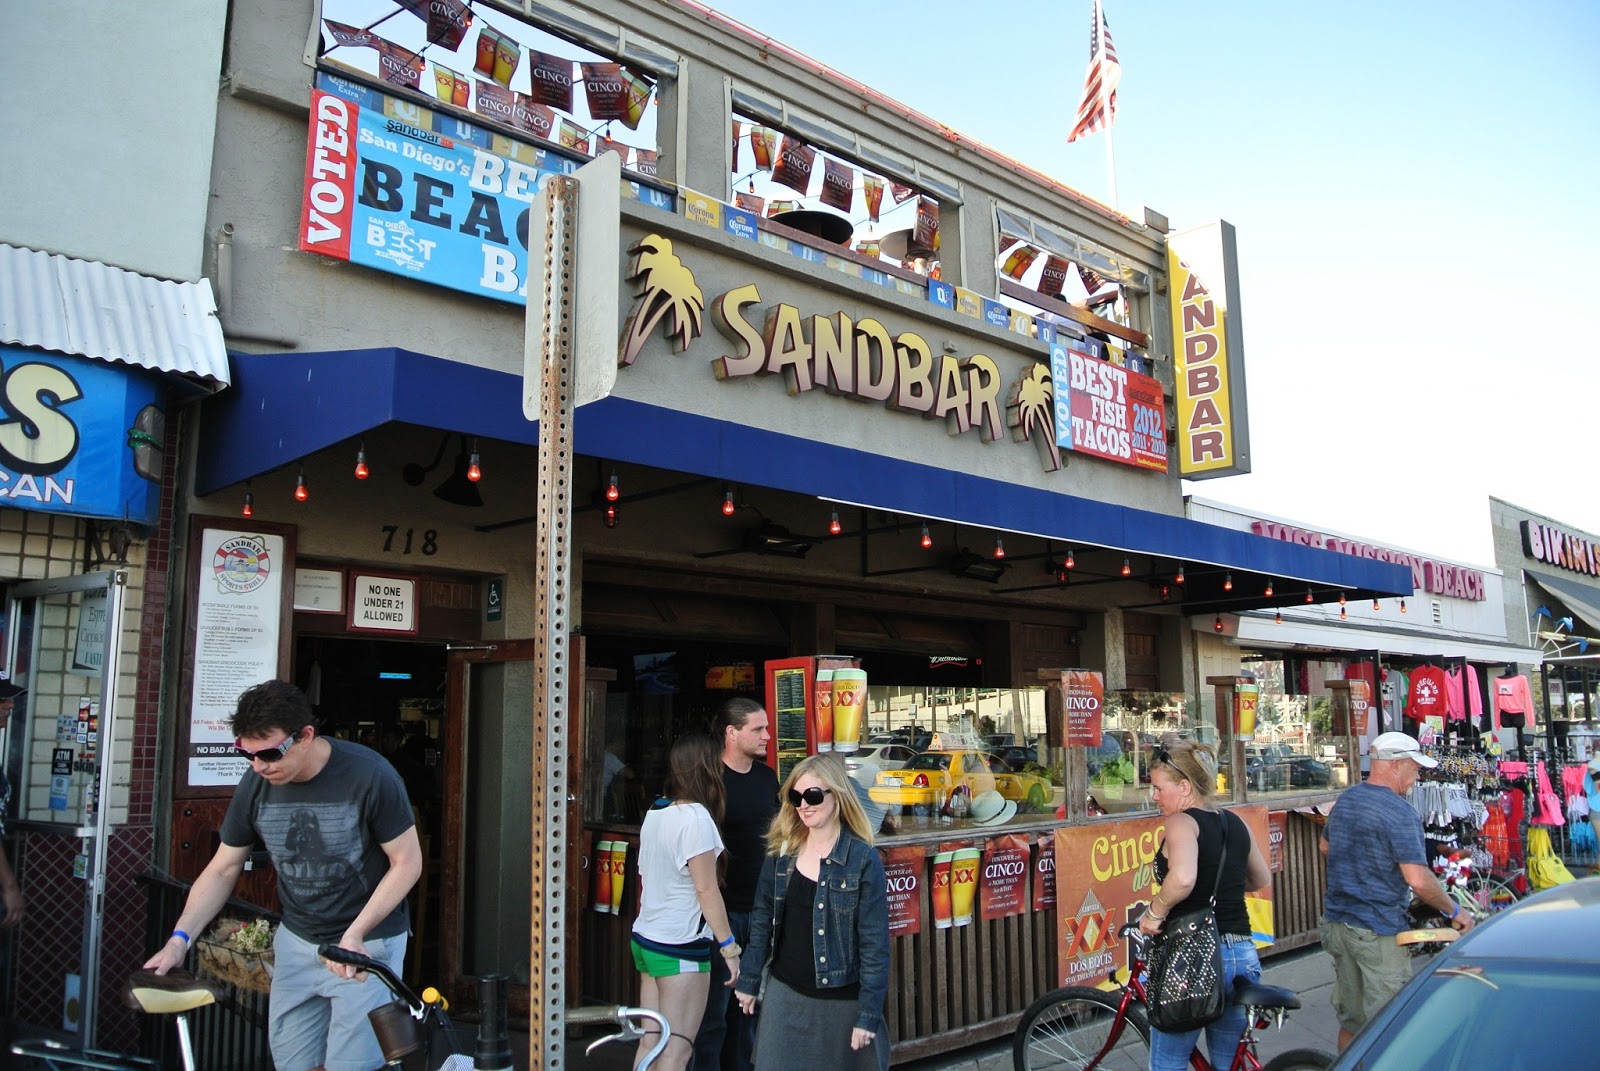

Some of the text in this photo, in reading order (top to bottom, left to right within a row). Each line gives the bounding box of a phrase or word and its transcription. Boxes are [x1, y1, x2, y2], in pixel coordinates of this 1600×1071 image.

[430, 1, 467, 28] CINCO
[380, 56, 419, 81] CINCO
[533, 67, 572, 88] CINCO
[587, 81, 623, 93] CINCO
[477, 96, 511, 115] CINCO
[515, 107, 550, 130] CINCO
[385, 119, 441, 144] sandbar
[360, 127, 398, 153] San
[402, 142, 471, 178] Diego's
[781, 150, 811, 173] CINCO
[308, 95, 349, 244] VOTED
[825, 171, 853, 192] CINCO
[367, 216, 386, 227] SAN
[688, 202, 715, 220] Corona
[728, 218, 754, 234] Corona
[735, 229, 750, 239] Extra
[366, 223, 437, 261] BEST
[480, 242, 528, 298] B
[1043, 268, 1068, 281] CINCO
[987, 310, 1007, 322] Corona
[711, 282, 1006, 442] SANDBAR
[1179, 261, 1225, 465] ANDBAR
[1068, 351, 1128, 405] BEST
[1053, 346, 1071, 441] VOTED
[1090, 395, 1128, 431] FISH
[1132, 402, 1163, 440] 2012
[1071, 416, 1131, 459] TACOS
[225, 540, 263, 555] SANDBAR
[381, 525, 438, 556] 718
[219, 573, 263, 592] SPORTS GRILL
[369, 584, 401, 597] NO ONE
[1424, 560, 1487, 601] BEACH
[363, 597, 405, 610] UNDER 21
[363, 610, 404, 623] ALLOWED
[1415, 677, 1439, 695] LIFEGUARD
[834, 690, 861, 707] XX
[55, 750, 70, 761] ATM
[197, 746, 239, 754] NO BAD AT
[991, 854, 1015, 862] DISCOVER
[953, 868, 976, 885] XX
[985, 861, 1025, 879] CINCO
[1132, 861, 1152, 893] de
[886, 875, 917, 893] NCO
[1064, 907, 1118, 959] XX
[1069, 951, 1114, 975] DOS EQUIS
